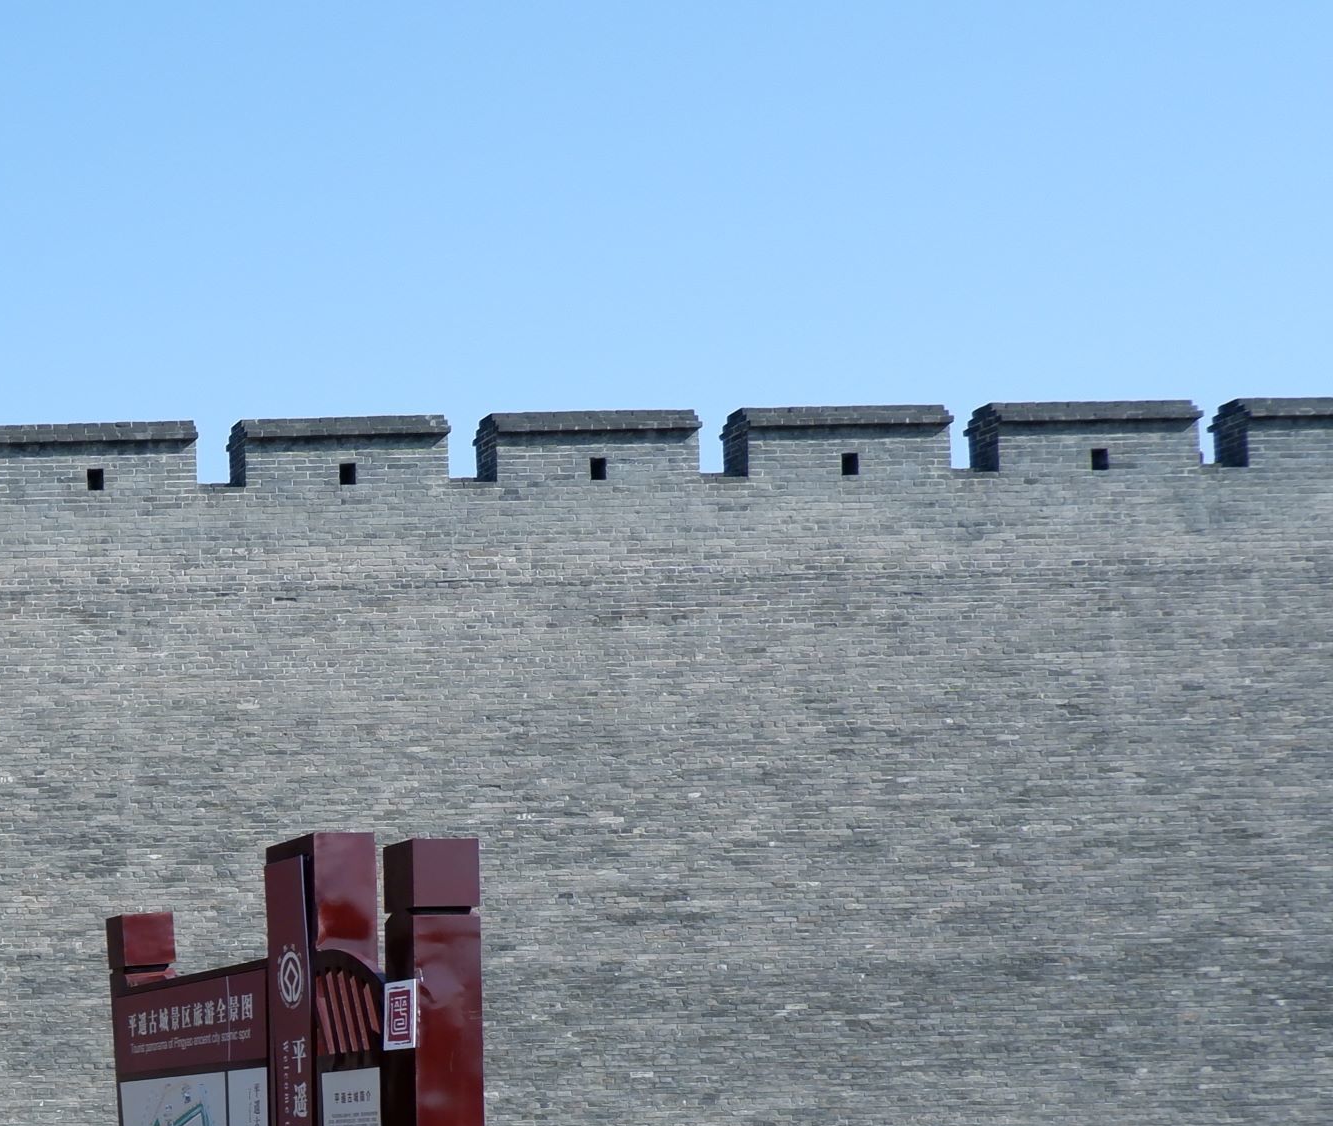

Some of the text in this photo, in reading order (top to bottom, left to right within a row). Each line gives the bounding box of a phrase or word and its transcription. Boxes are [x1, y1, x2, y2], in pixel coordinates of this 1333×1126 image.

[128, 993, 253, 1037] 平遥古城景区旅游全景图
